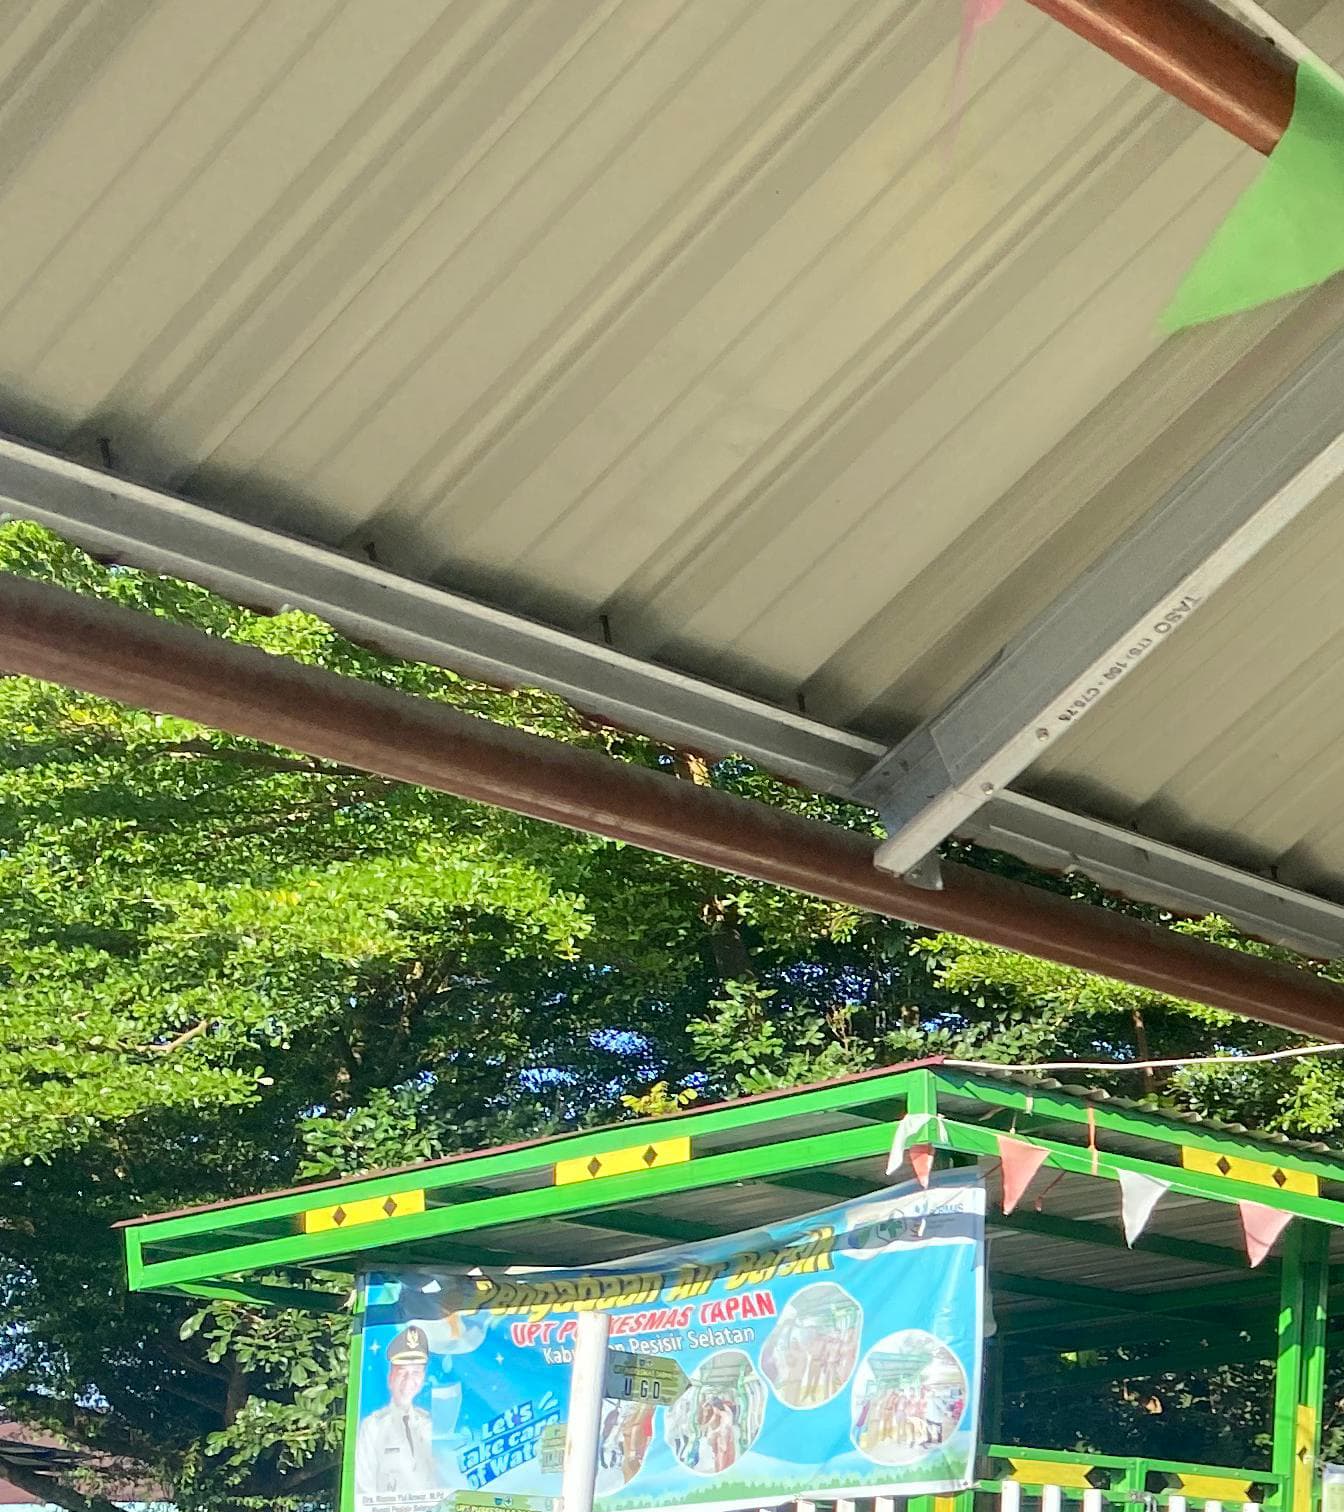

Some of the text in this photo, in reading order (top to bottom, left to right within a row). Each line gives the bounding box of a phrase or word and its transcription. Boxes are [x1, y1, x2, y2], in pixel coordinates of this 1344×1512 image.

[1153, 596, 1200, 634] TASO
[461, 1227, 836, 1324] Pengadaan Air Bersih
[512, 1291, 777, 1347] UPT PKESMAS TAPAN
[630, 1333, 684, 1354] Pesisir
[688, 1326, 755, 1350] Selatan
[481, 1401, 534, 1440] Let's
[461, 1436, 506, 1473] take
[467, 1463, 487, 1490] of
